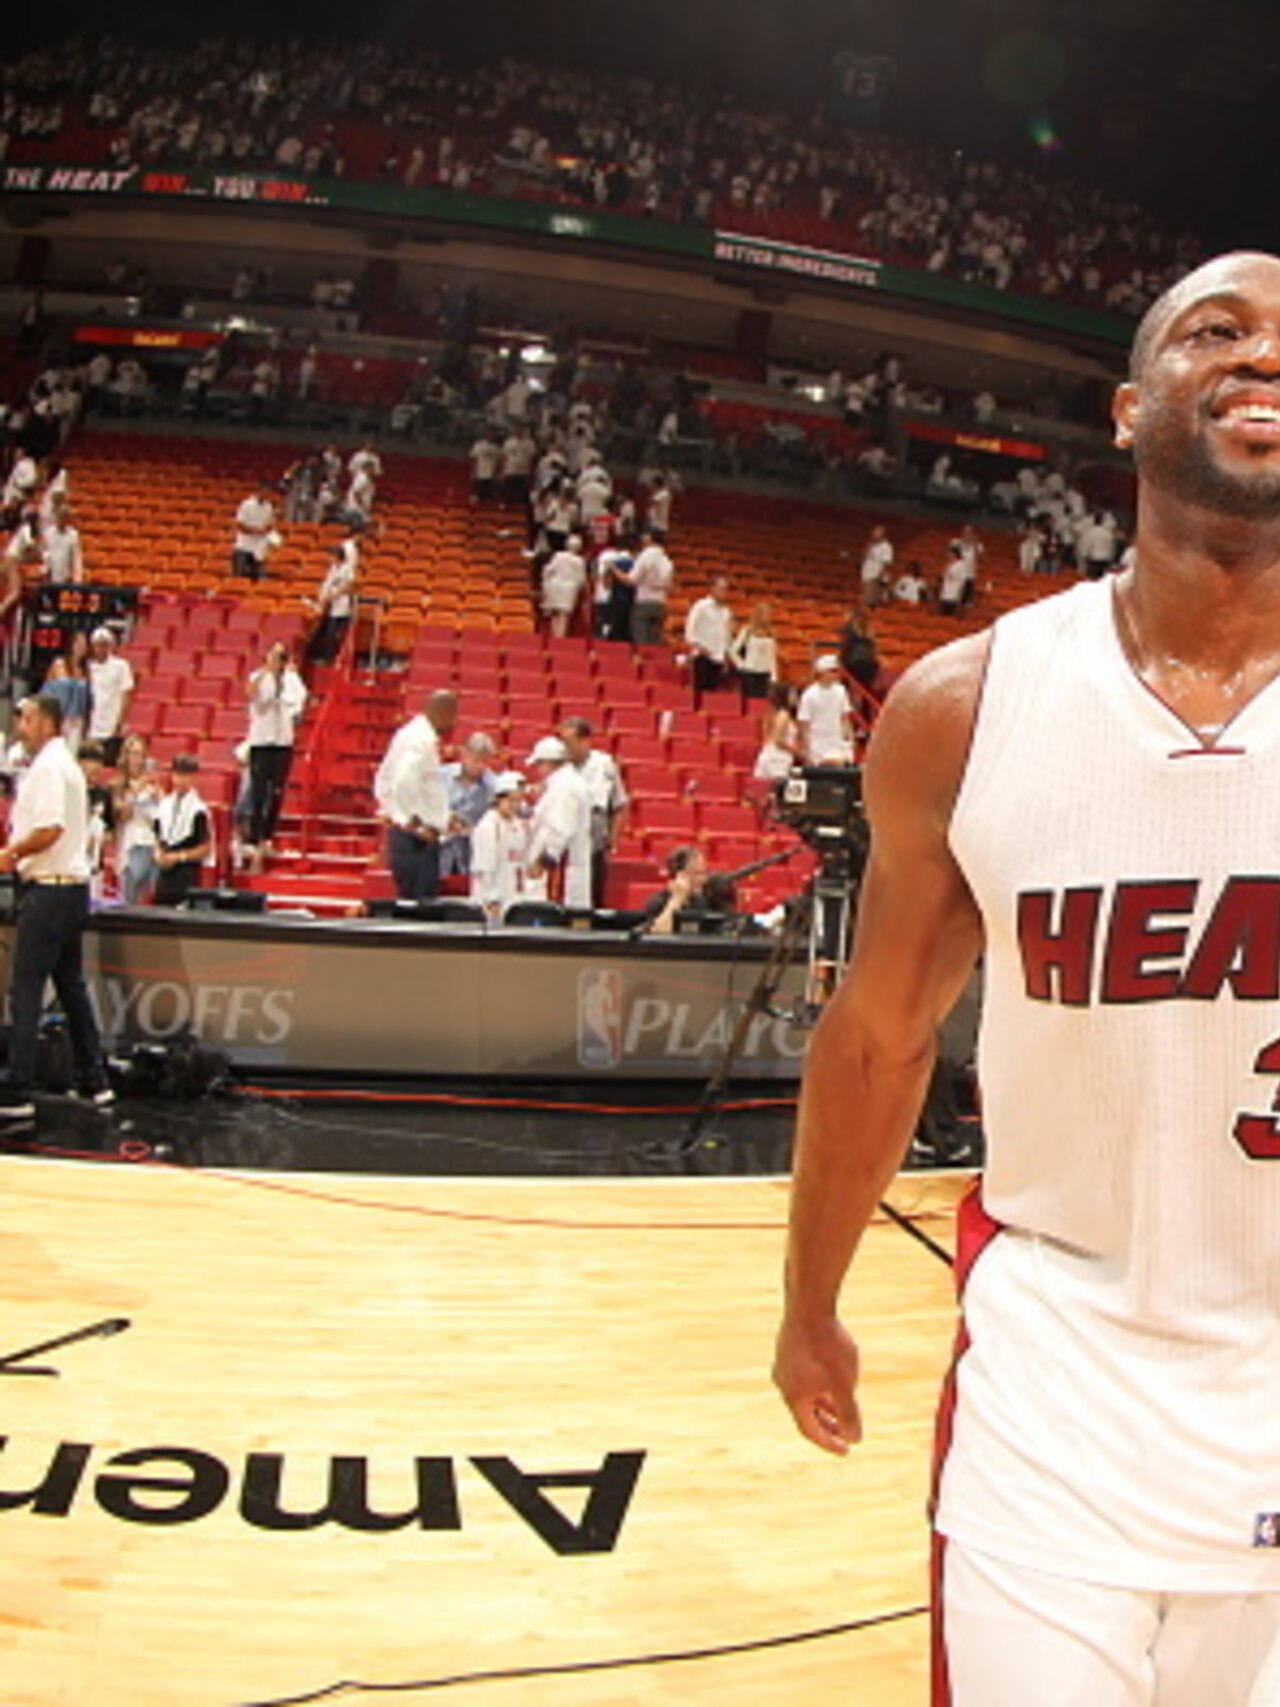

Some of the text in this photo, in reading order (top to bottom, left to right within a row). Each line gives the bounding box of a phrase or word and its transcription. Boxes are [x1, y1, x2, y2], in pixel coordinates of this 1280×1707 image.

[3, 167, 43, 190] THE
[47, 164, 140, 191] HEAT
[214, 176, 255, 198] YOU
[84, 976, 295, 1044] YOFFS
